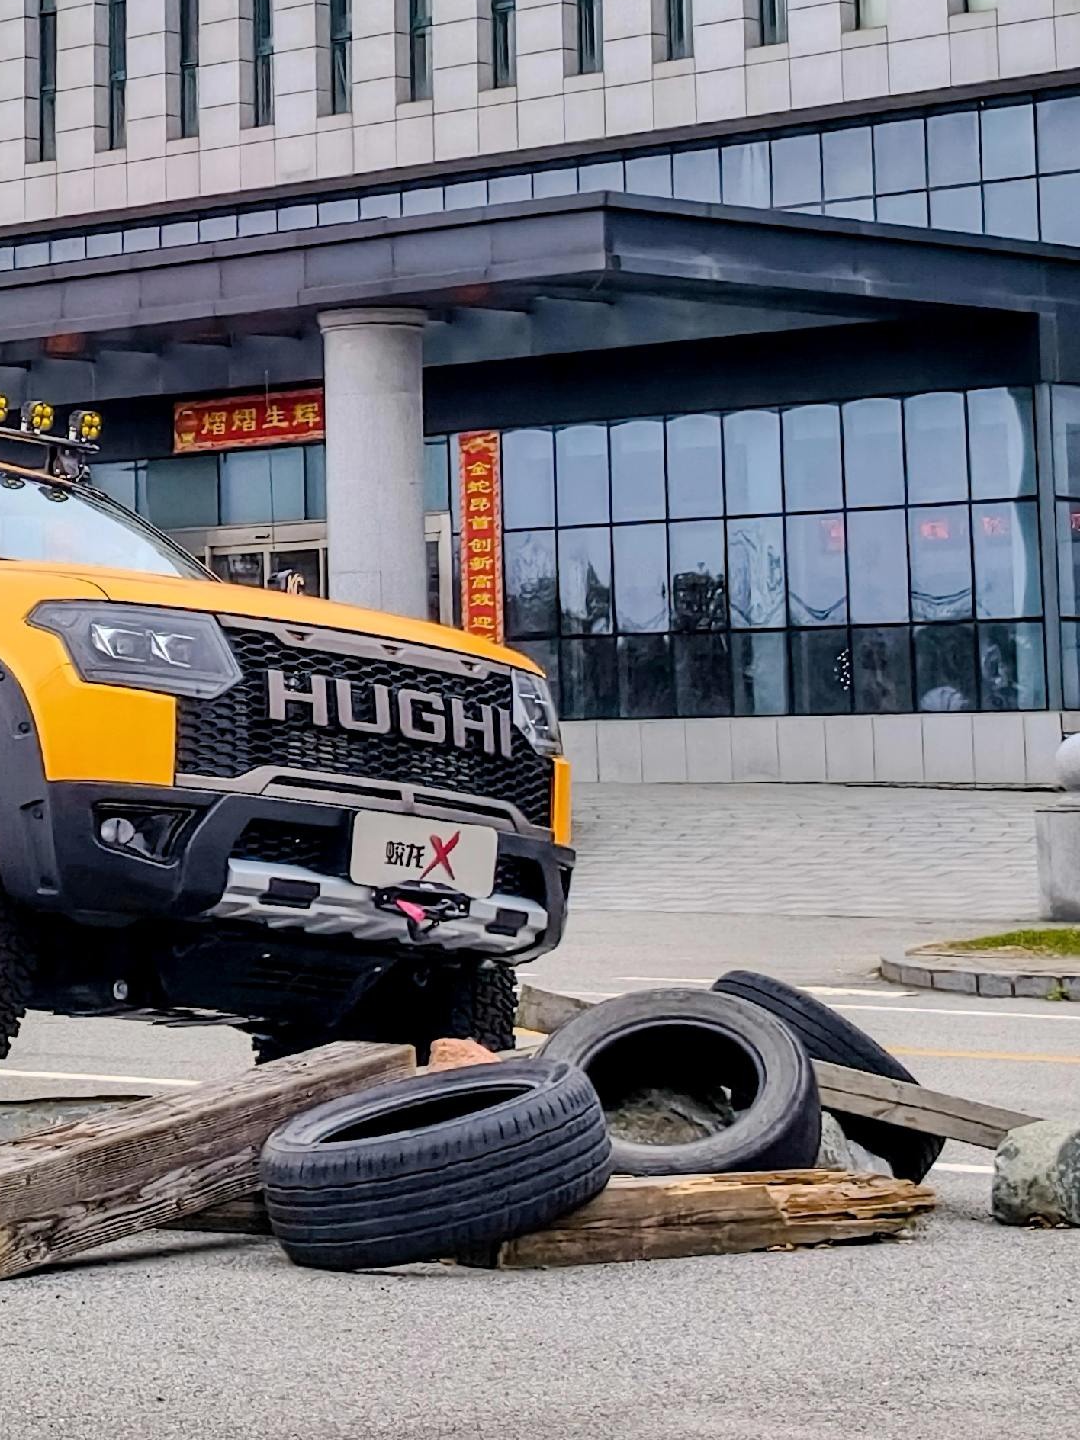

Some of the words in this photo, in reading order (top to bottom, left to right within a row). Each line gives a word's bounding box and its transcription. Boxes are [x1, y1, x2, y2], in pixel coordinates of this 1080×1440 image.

[200, 401, 321, 436] 熠熠生辉
[466, 461, 496, 642] 金蛇昂首创新高效迎
[266, 668, 512, 758] HUGHI
